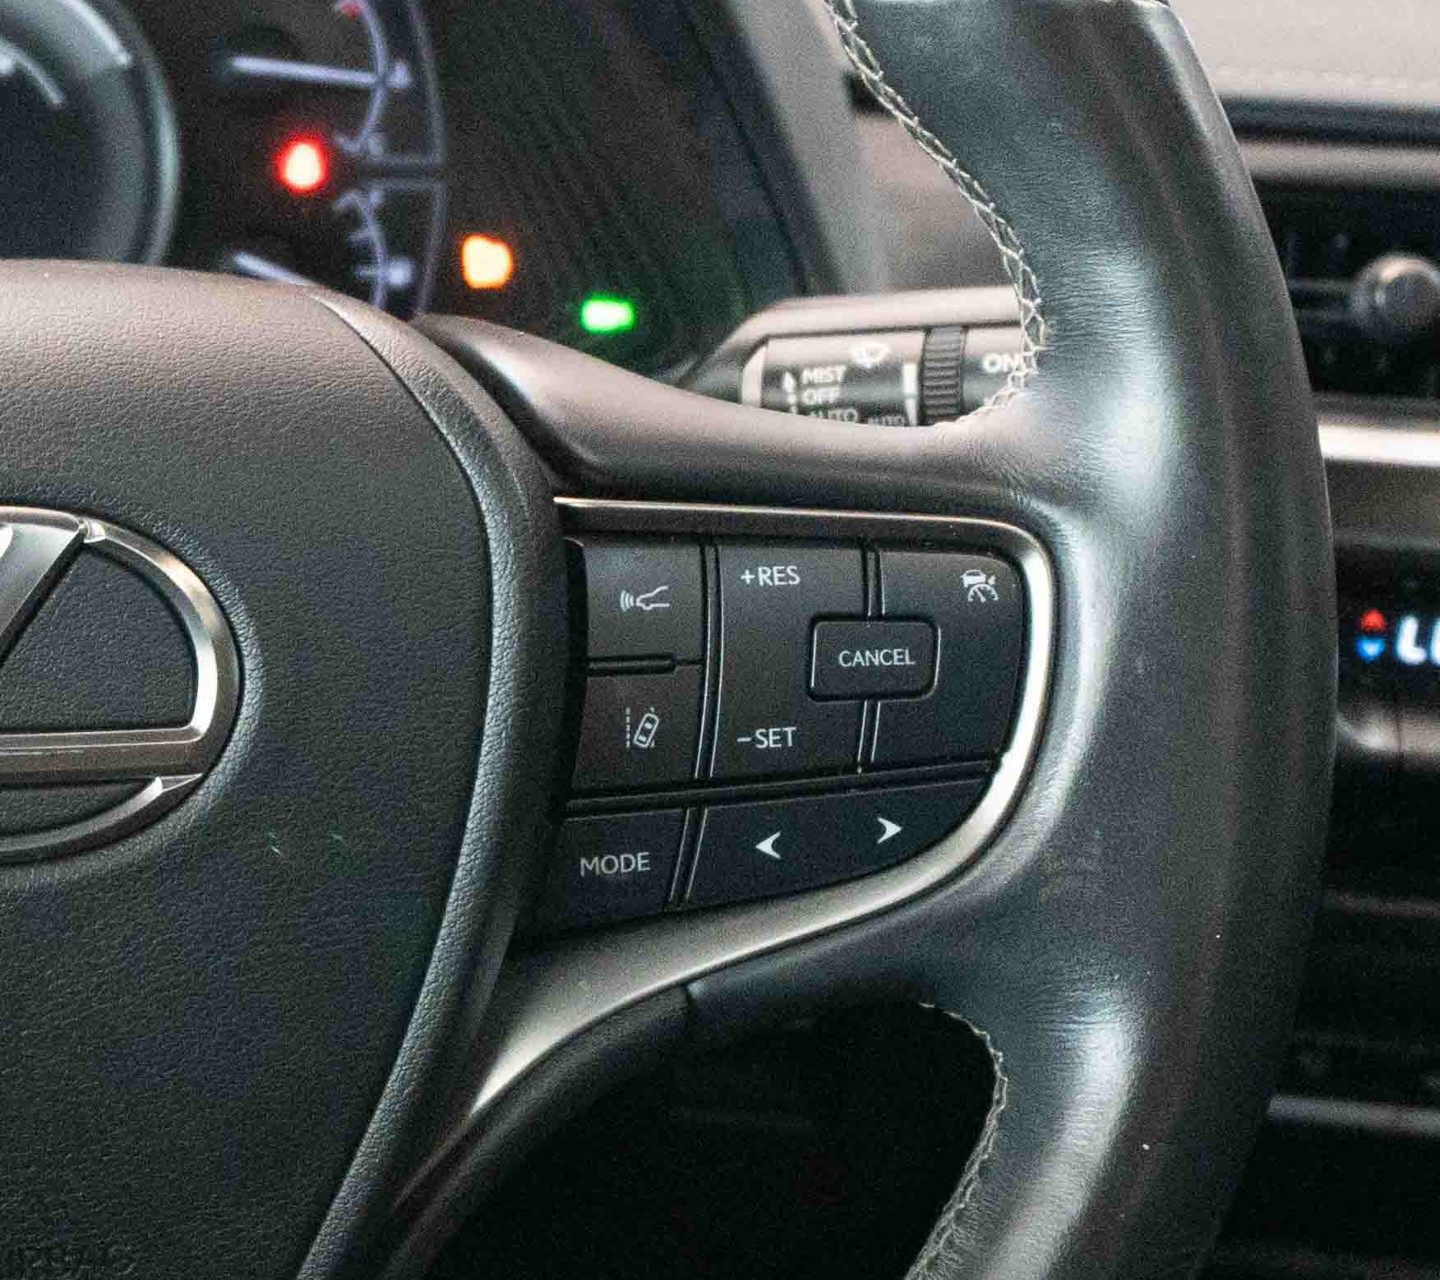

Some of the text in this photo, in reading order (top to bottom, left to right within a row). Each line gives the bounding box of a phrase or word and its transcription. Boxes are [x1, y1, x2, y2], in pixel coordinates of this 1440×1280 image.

[740, 565, 801, 586] +RES
[838, 649, 917, 669] CANCEL
[579, 851, 652, 878] MODE
